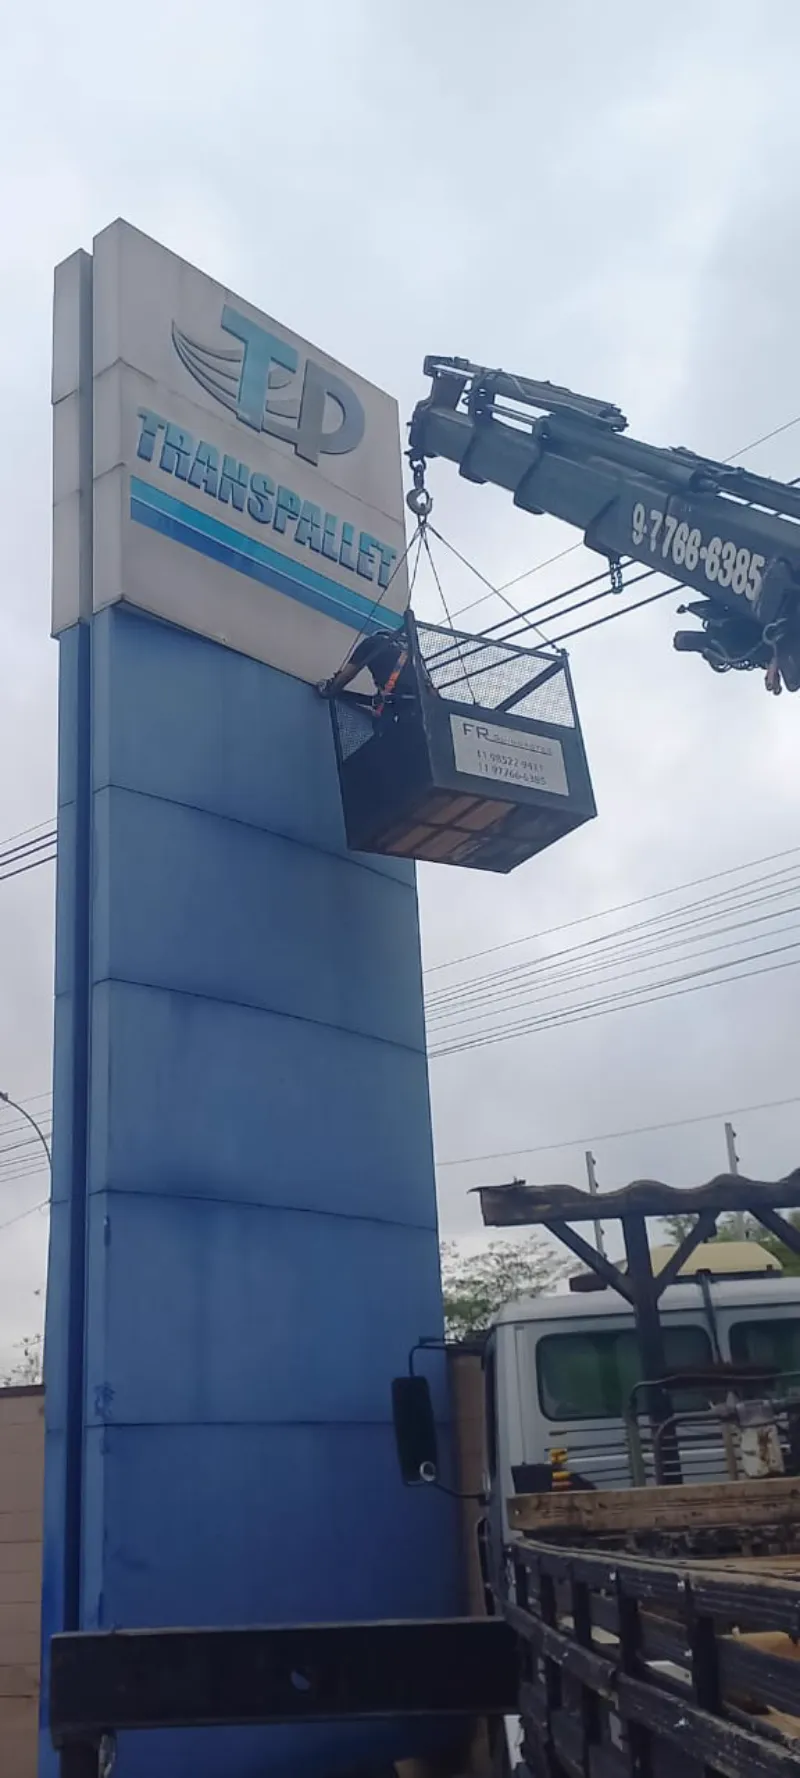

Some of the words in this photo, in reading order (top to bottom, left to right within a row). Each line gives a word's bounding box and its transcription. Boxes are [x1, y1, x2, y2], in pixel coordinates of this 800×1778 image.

[221, 304, 365, 467] TP
[137, 405, 396, 589] TRANSPALLET
[462, 723, 489, 740] FR
